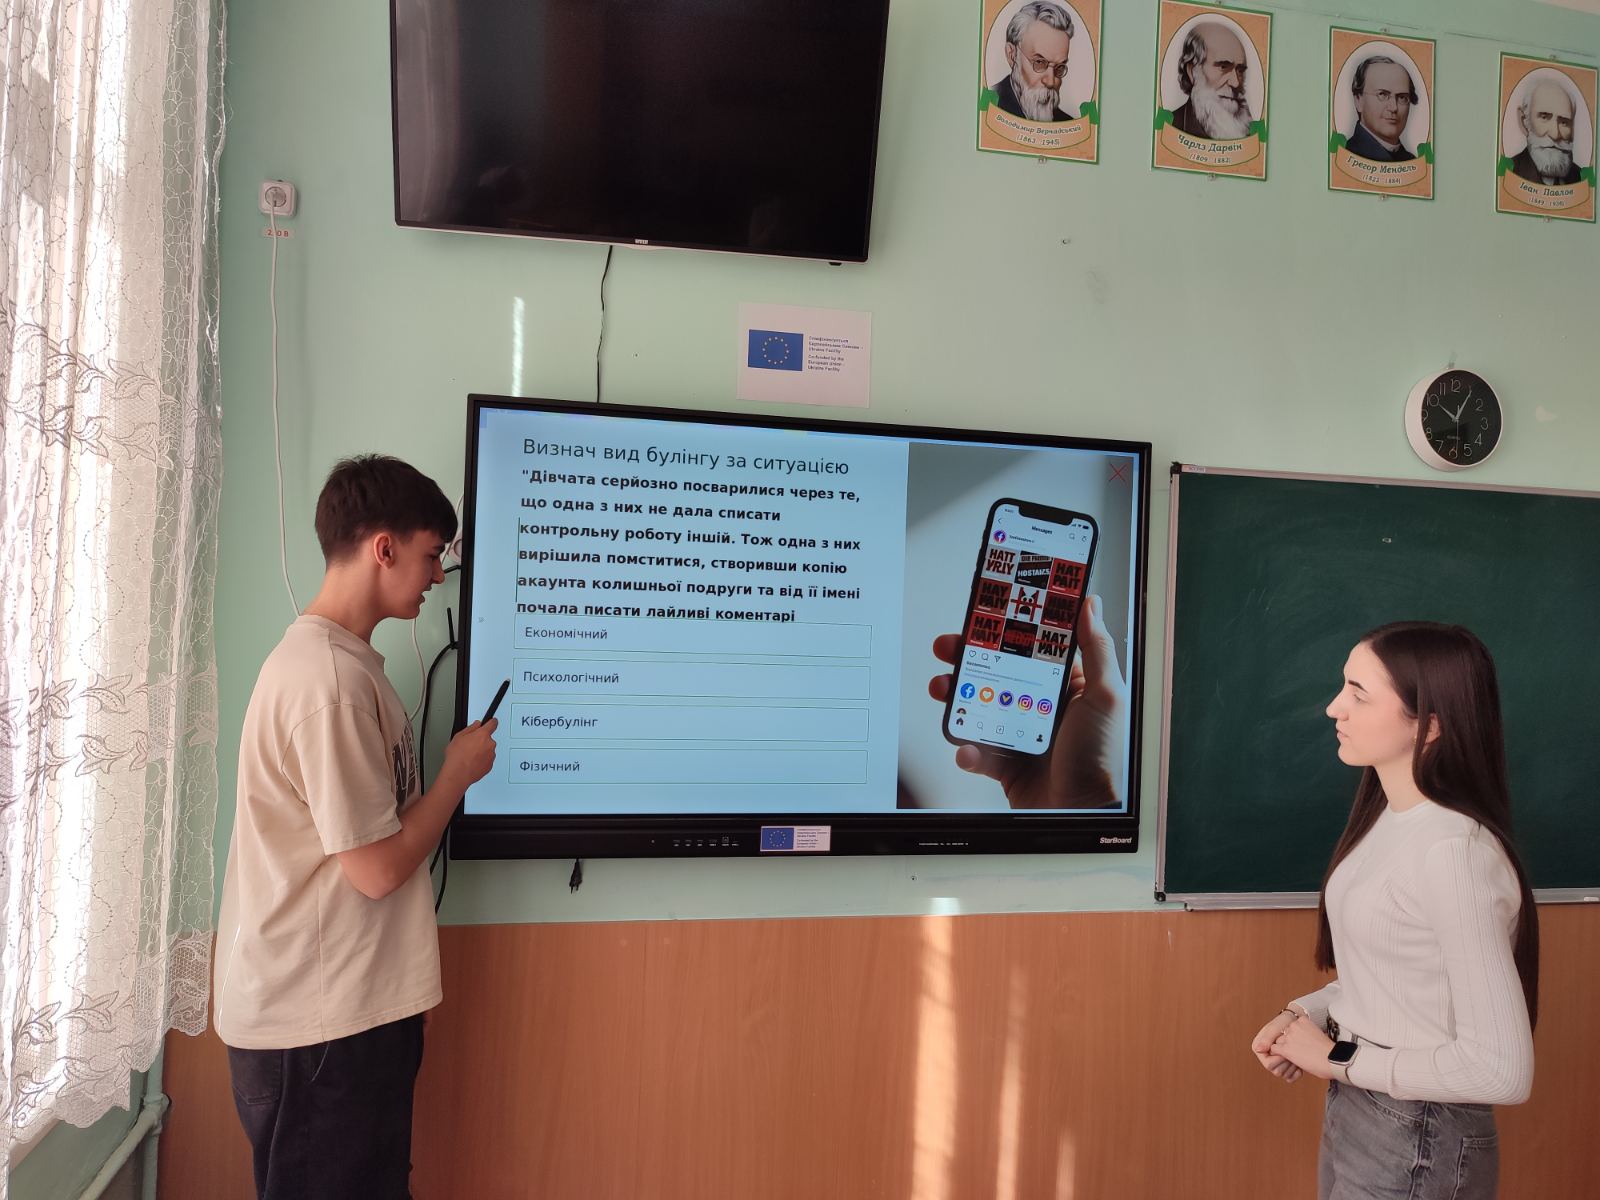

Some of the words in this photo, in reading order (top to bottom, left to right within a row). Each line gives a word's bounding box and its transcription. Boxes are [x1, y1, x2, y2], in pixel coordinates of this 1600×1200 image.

[1178, 134, 1206, 151] Чарлз
[1208, 142, 1242, 154] Дарвін
[1347, 155, 1377, 174] Грегор
[1380, 163, 1417, 174] Мендель
[1520, 182, 1538, 195] Іван
[1543, 188, 1574, 197] Павлов
[1440, 382, 1446, 396] 11
[1451, 379, 1460, 393] 12
[1427, 393, 1439, 407] 10
[1475, 398, 1483, 411] 2
[1480, 417, 1488, 430] 3
[1426, 427, 1432, 440] 8
[1474, 433, 1482, 446] 4
[1435, 440, 1443, 453] 7
[1449, 446, 1458, 459] 6
[1463, 443, 1472, 457] 5
[524, 438, 595, 458] Визнач
[604, 448, 640, 463] вид
[647, 446, 720, 470] булінгу
[726, 455, 746, 468] за
[753, 458, 849, 475] ситуацією
[522, 469, 595, 485] "Дівчата
[601, 475, 678, 490] серйозно
[683, 482, 784, 496] посварилися
[790, 488, 834, 501] через
[839, 491, 859, 503] те,
[521, 498, 547, 510] що
[553, 500, 594, 512] одна
[600, 502, 608, 511] з
[614, 503, 643, 513] них
[649, 505, 667, 515] не
[673, 506, 713, 518] дала
[718, 509, 780, 521] списати
[520, 525, 619, 541] контрольну
[625, 528, 682, 544] роботу
[687, 530, 735, 544] іншій.
[741, 533, 773, 546] Тож
[778, 538, 816, 549] одна
[821, 540, 829, 548] з
[834, 540, 860, 550] них
[519, 550, 600, 563] вирішила
[607, 554, 705, 570] помститися,
[711, 559, 797, 572] створивши
[802, 562, 847, 574] копію
[517, 577, 586, 592] акаунта
[592, 580, 682, 592] колишньої
[687, 584, 752, 597] подруги
[757, 586, 774, 596] та
[780, 585, 803, 599] від
[808, 586, 818, 597] її
[823, 586, 860, 599] імені
[517, 603, 578, 614] почала
[585, 606, 640, 616] писати
[646, 606, 709, 619] лайливі
[716, 610, 795, 623] коментарі
[525, 627, 607, 639] Економічний
[1041, 629, 1068, 645] HAT
[524, 671, 619, 683] Психологічний
[522, 716, 598, 730] Кібербулінг
[520, 761, 580, 771] Фізичний
[1099, 836, 1133, 844] StarBoard
